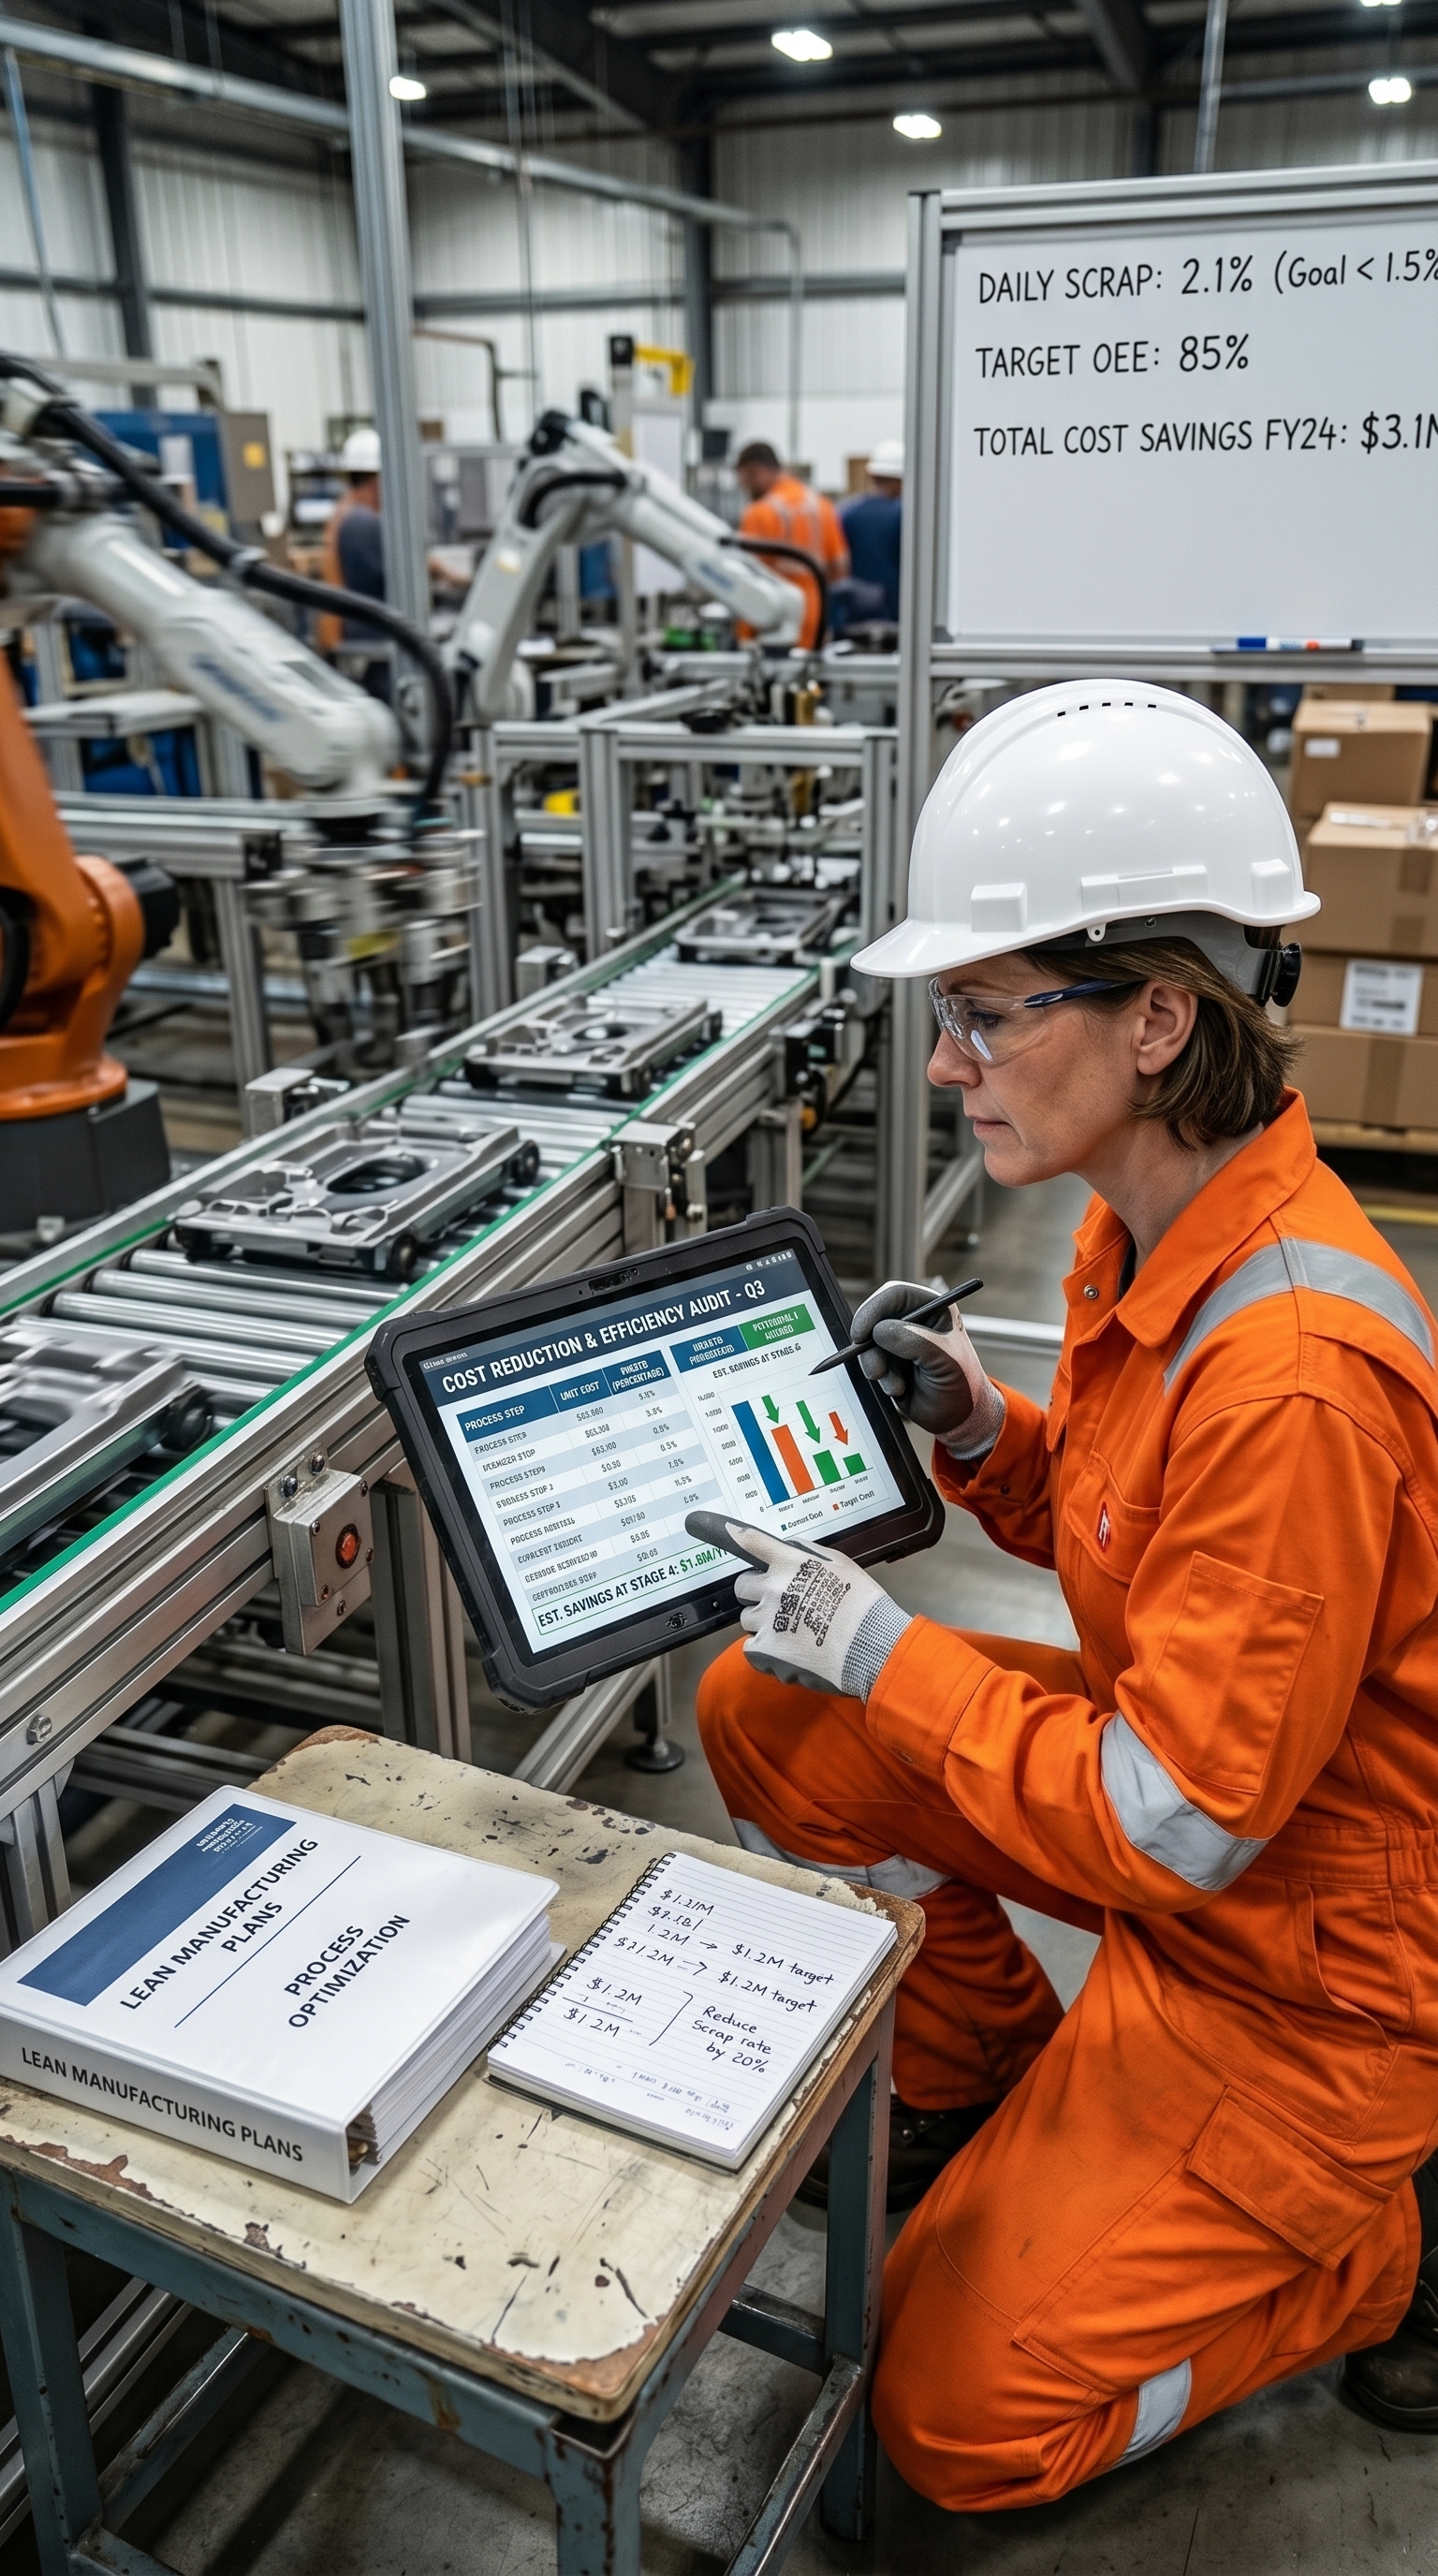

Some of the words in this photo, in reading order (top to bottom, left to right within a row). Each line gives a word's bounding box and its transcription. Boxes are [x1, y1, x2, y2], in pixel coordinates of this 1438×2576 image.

[979, 269, 1054, 303] DAILY
[1064, 264, 1162, 299] SCRAP:
[1181, 255, 1253, 294] 2.1%
[1274, 250, 1346, 294] (Goal
[975, 344, 1080, 378] TARGET
[1093, 341, 1159, 373] OEE:
[1180, 333, 1249, 372] 85%
[974, 427, 1053, 456] TOTAL
[1064, 424, 1129, 454] COST
[1140, 420, 1252, 452] SAVINGS
[1266, 417, 1347, 450] FY24:
[442, 1365, 487, 1393] COST
[490, 1337, 583, 1378] REDUCTION
[585, 1332, 598, 1348] &
[599, 1304, 685, 1344] EFFICIENCY
[689, 1289, 732, 1317] AUDIT
[744, 1280, 766, 1300] Q3
[464, 1412, 504, 1431] PROCESS
[504, 1405, 526, 1420] STEP
[537, 1609, 563, 1628] EST.
[565, 1588, 613, 1617] SAVINGS
[614, 1583, 633, 1599] AT
[631, 1568, 667, 1591] STAGE
[668, 1564, 680, 1577] 4:
[120, 1967, 177, 2010] LEAN
[170, 1837, 319, 1968] MANUFACTURING
[221, 1901, 284, 1954] PLANS
[283, 1924, 365, 1998] PROCESS
[287, 1913, 412, 2030] OPTIMIZATION
[731, 1943, 784, 1969] $1.2M
[786, 1962, 835, 1985] target
[586, 1977, 642, 2006] $1.2M
[718, 1970, 768, 1997] $1.2M
[770, 1989, 817, 2013] target
[563, 2008, 621, 2038] $1.2M
[702, 2005, 757, 2034] Reduce
[706, 2042, 726, 2061] by
[731, 2052, 770, 2073] 20%
[740, 2040, 772, 2055] rate
[22, 2045, 68, 2079] LEAN
[71, 2062, 237, 2140] MANUFACTURING
[240, 2126, 304, 2163] PLANS
